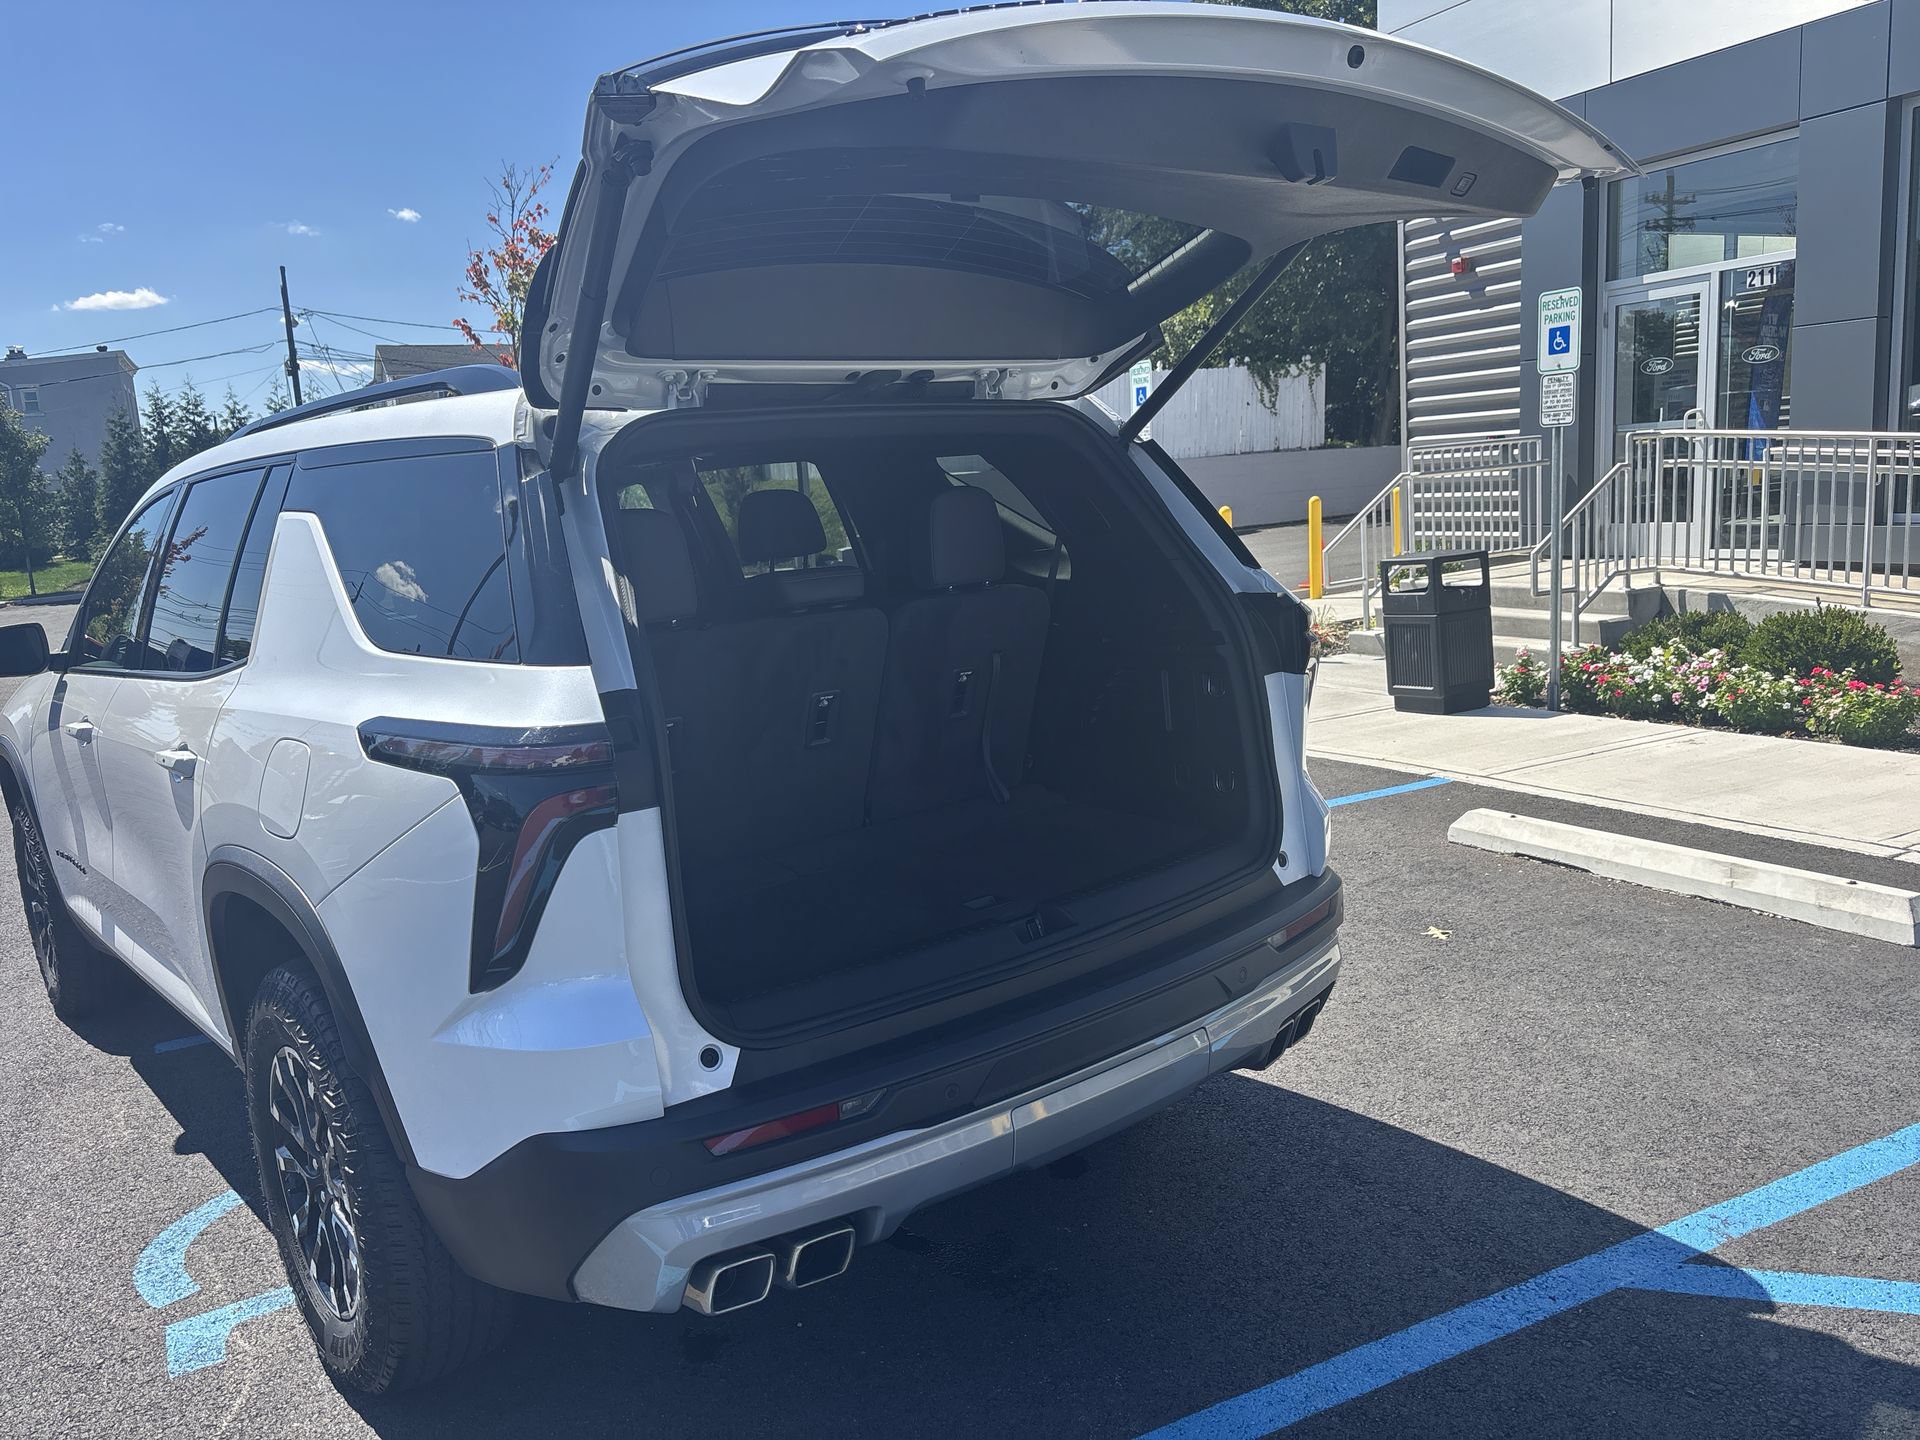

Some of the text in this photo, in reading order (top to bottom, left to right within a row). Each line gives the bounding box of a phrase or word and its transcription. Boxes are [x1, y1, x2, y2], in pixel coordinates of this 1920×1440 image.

[1748, 267, 1775, 287] 211
[1543, 296, 1578, 311] RESERVED
[1544, 311, 1575, 325] PARKING
[1749, 348, 1772, 361] Ford
[1646, 359, 1668, 372] Ford
